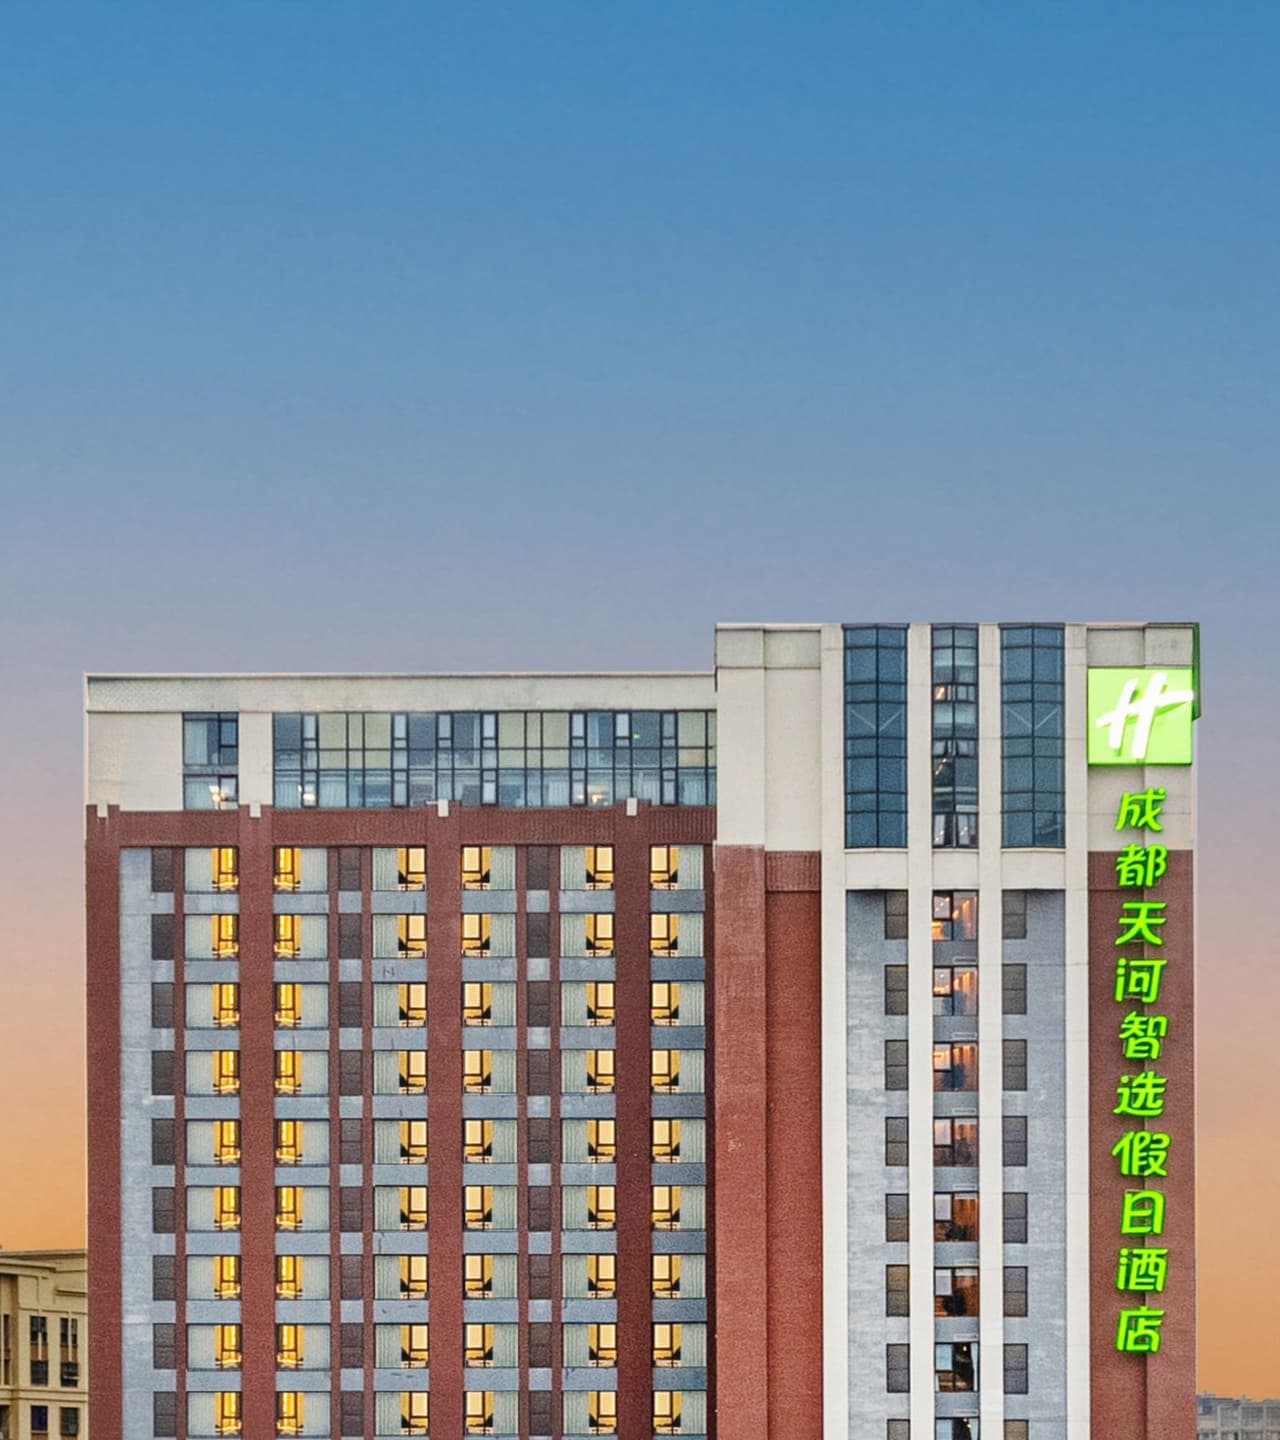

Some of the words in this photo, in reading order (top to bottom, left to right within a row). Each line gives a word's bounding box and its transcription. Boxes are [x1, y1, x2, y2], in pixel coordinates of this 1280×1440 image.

[1111, 786, 1171, 1356] 成都天河智选假日酒店
